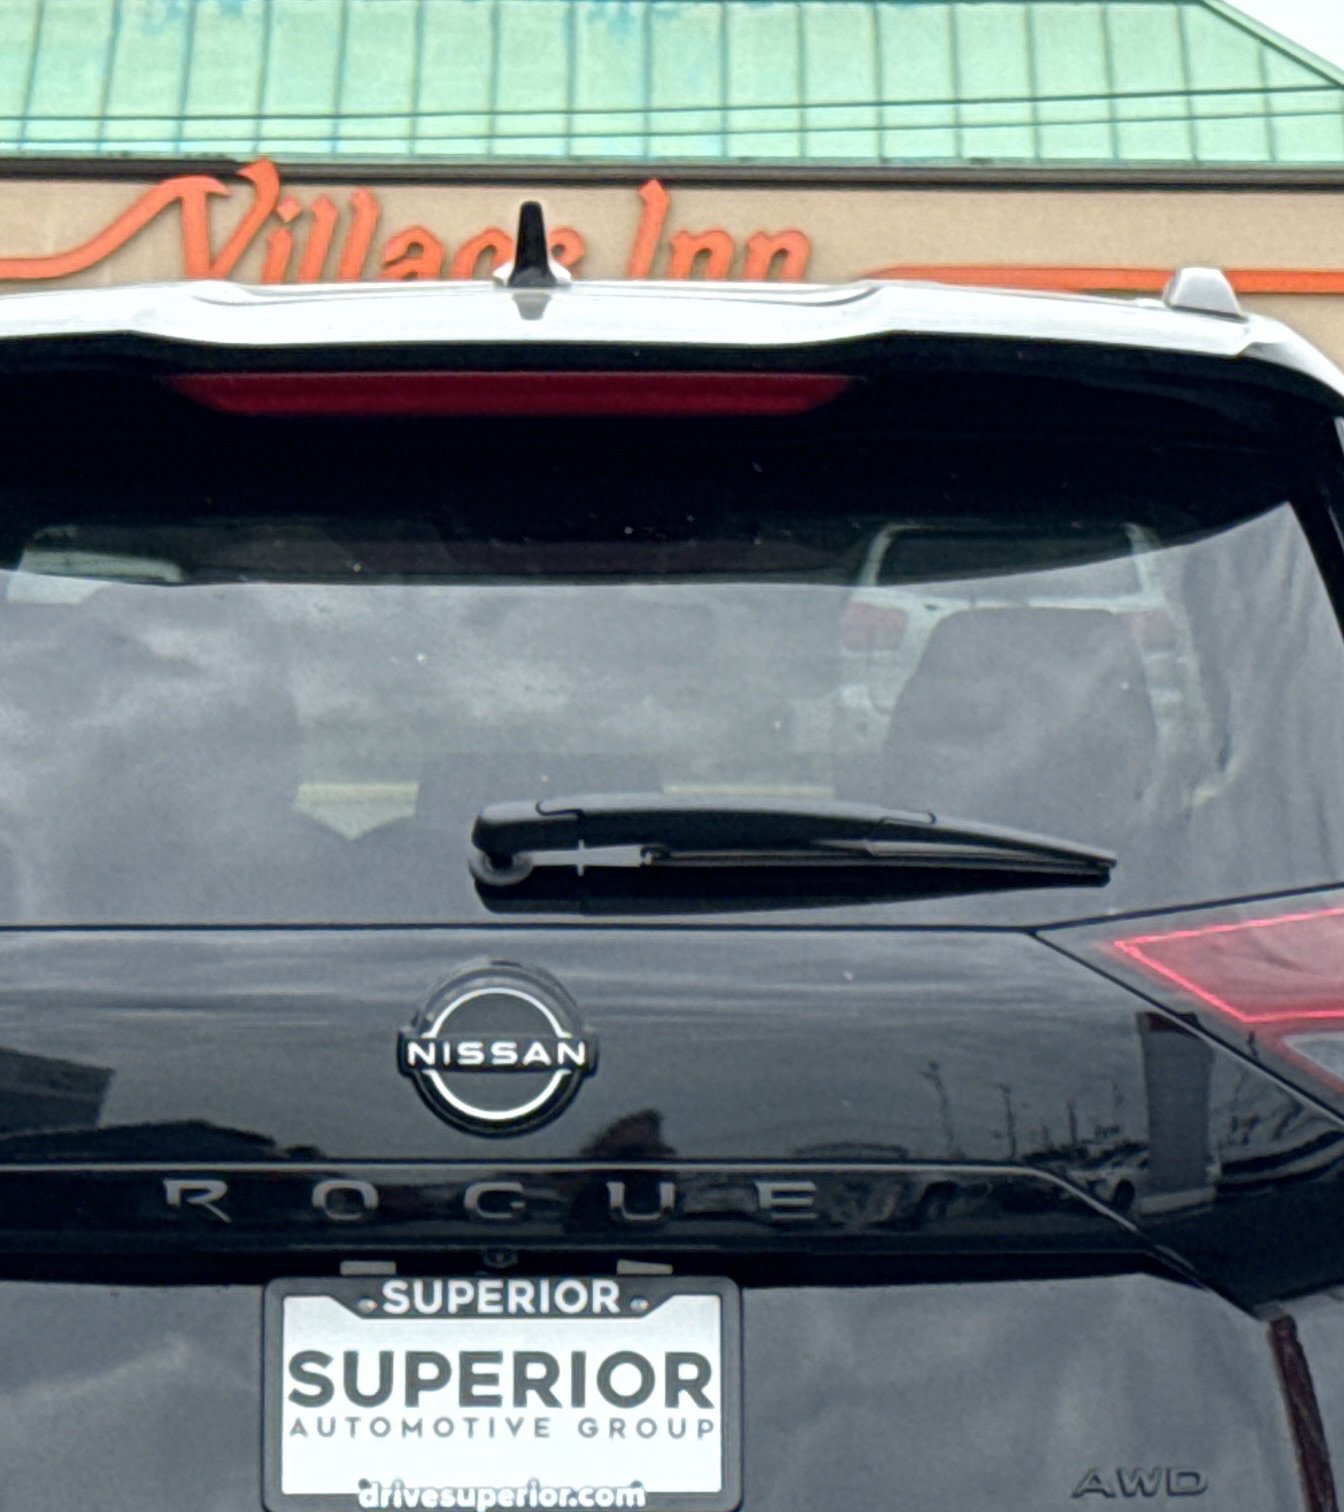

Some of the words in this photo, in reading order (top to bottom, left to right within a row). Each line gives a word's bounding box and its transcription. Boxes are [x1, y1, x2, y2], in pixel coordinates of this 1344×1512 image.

[627, 179, 810, 283] Inn
[407, 1040, 587, 1067] NISSAN
[163, 1178, 819, 1222] ROGUE
[382, 1279, 621, 1315] SUPERIOR
[287, 1349, 716, 1410] SUPERIOR
[288, 1415, 551, 1440] AUTOMOTIVE
[576, 1415, 716, 1441] GROUP
[1071, 1466, 1209, 1499] AWD
